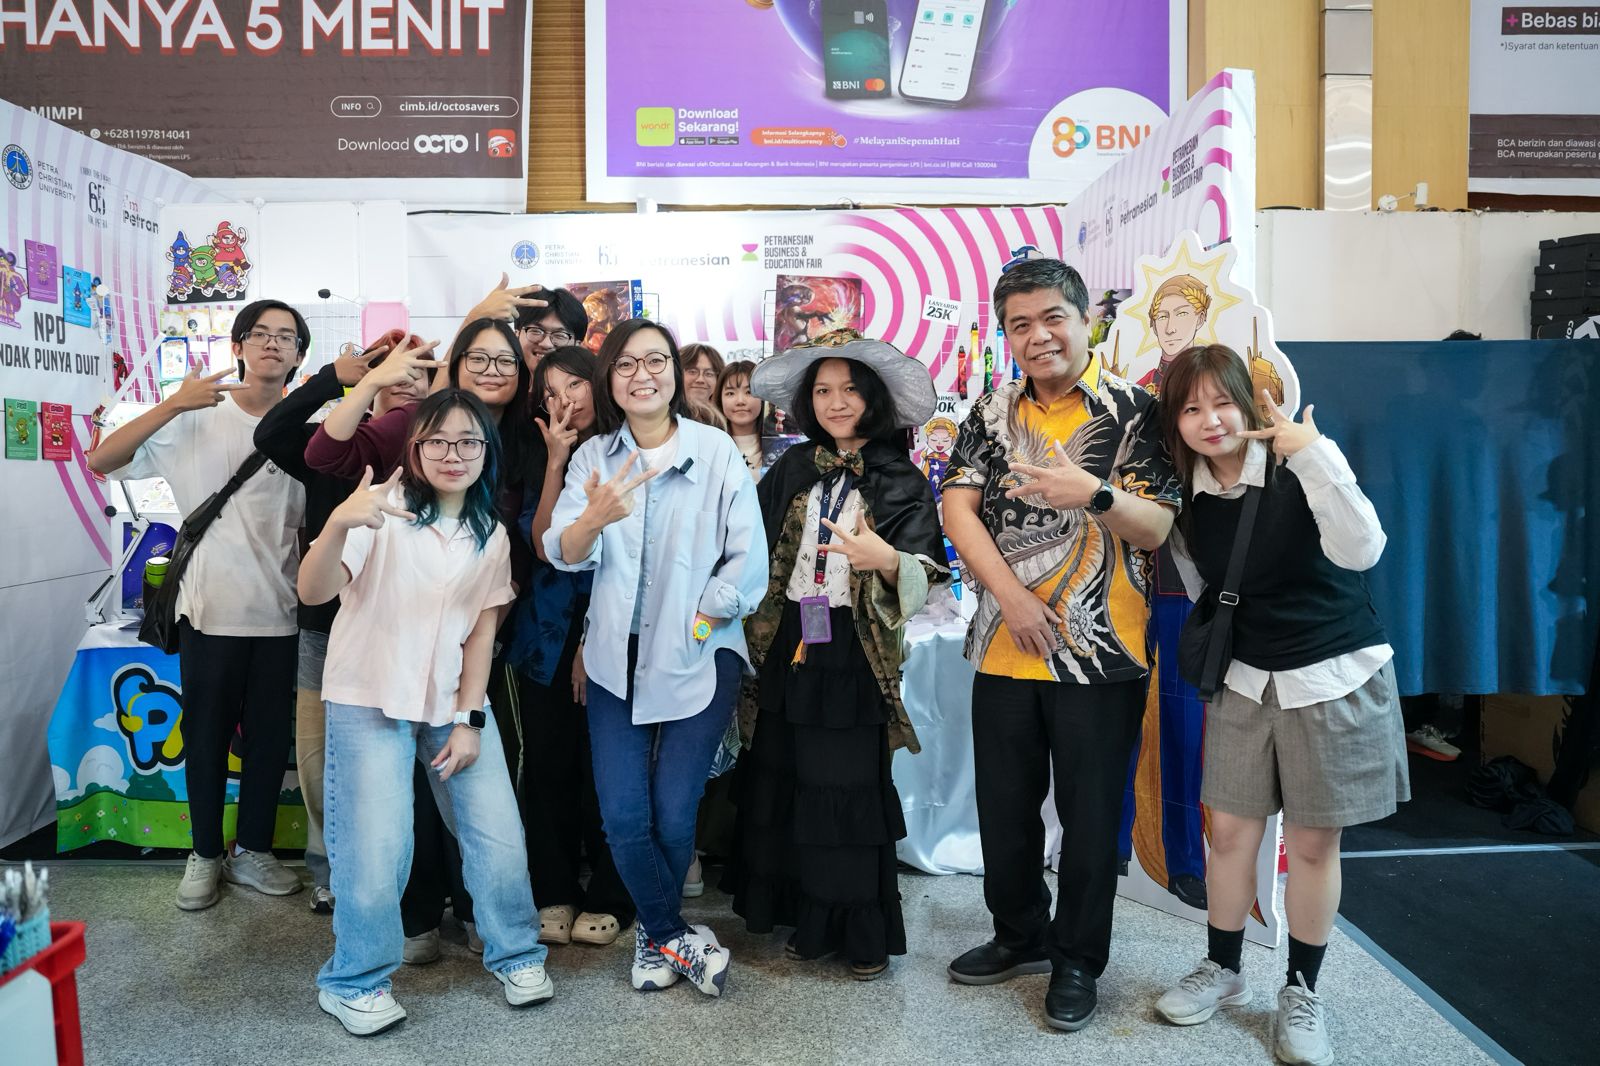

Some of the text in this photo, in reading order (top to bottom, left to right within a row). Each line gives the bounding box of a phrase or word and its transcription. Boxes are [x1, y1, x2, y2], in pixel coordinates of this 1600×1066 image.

[1582, 12, 1600, 28] bi
[0, 0, 505, 56] HANYA 5 MENIT
[1538, 42, 1554, 50] dan
[1556, 42, 1599, 50] ketentuan
[842, 81, 860, 89] BNI
[341, 102, 500, 112] INFO cimb.id/octosavers
[678, 108, 739, 119] Download
[678, 121, 739, 134] Sekarang!
[104, 128, 190, 140] +6281197814041
[337, 134, 469, 153] Download OCTO
[1497, 139, 1596, 147] BCA berizin dan diawasi
[1497, 150, 1597, 160] BCA merupakan peserta
[37, 160, 59, 175] PETRA
[38, 171, 73, 191] CHRISTIAN
[38, 183, 76, 201] UNIVERSITY
[764, 235, 814, 246] PETRANESIAN
[764, 247, 807, 258] BUSINESS &
[764, 258, 823, 269] EDUCATION FAIR
[926, 305, 953, 321] 25K
[33, 311, 66, 345] NPD
[34, 347, 72, 374] PUNYA
[75, 353, 100, 377] DUIT
[936, 401, 957, 413] 0K
